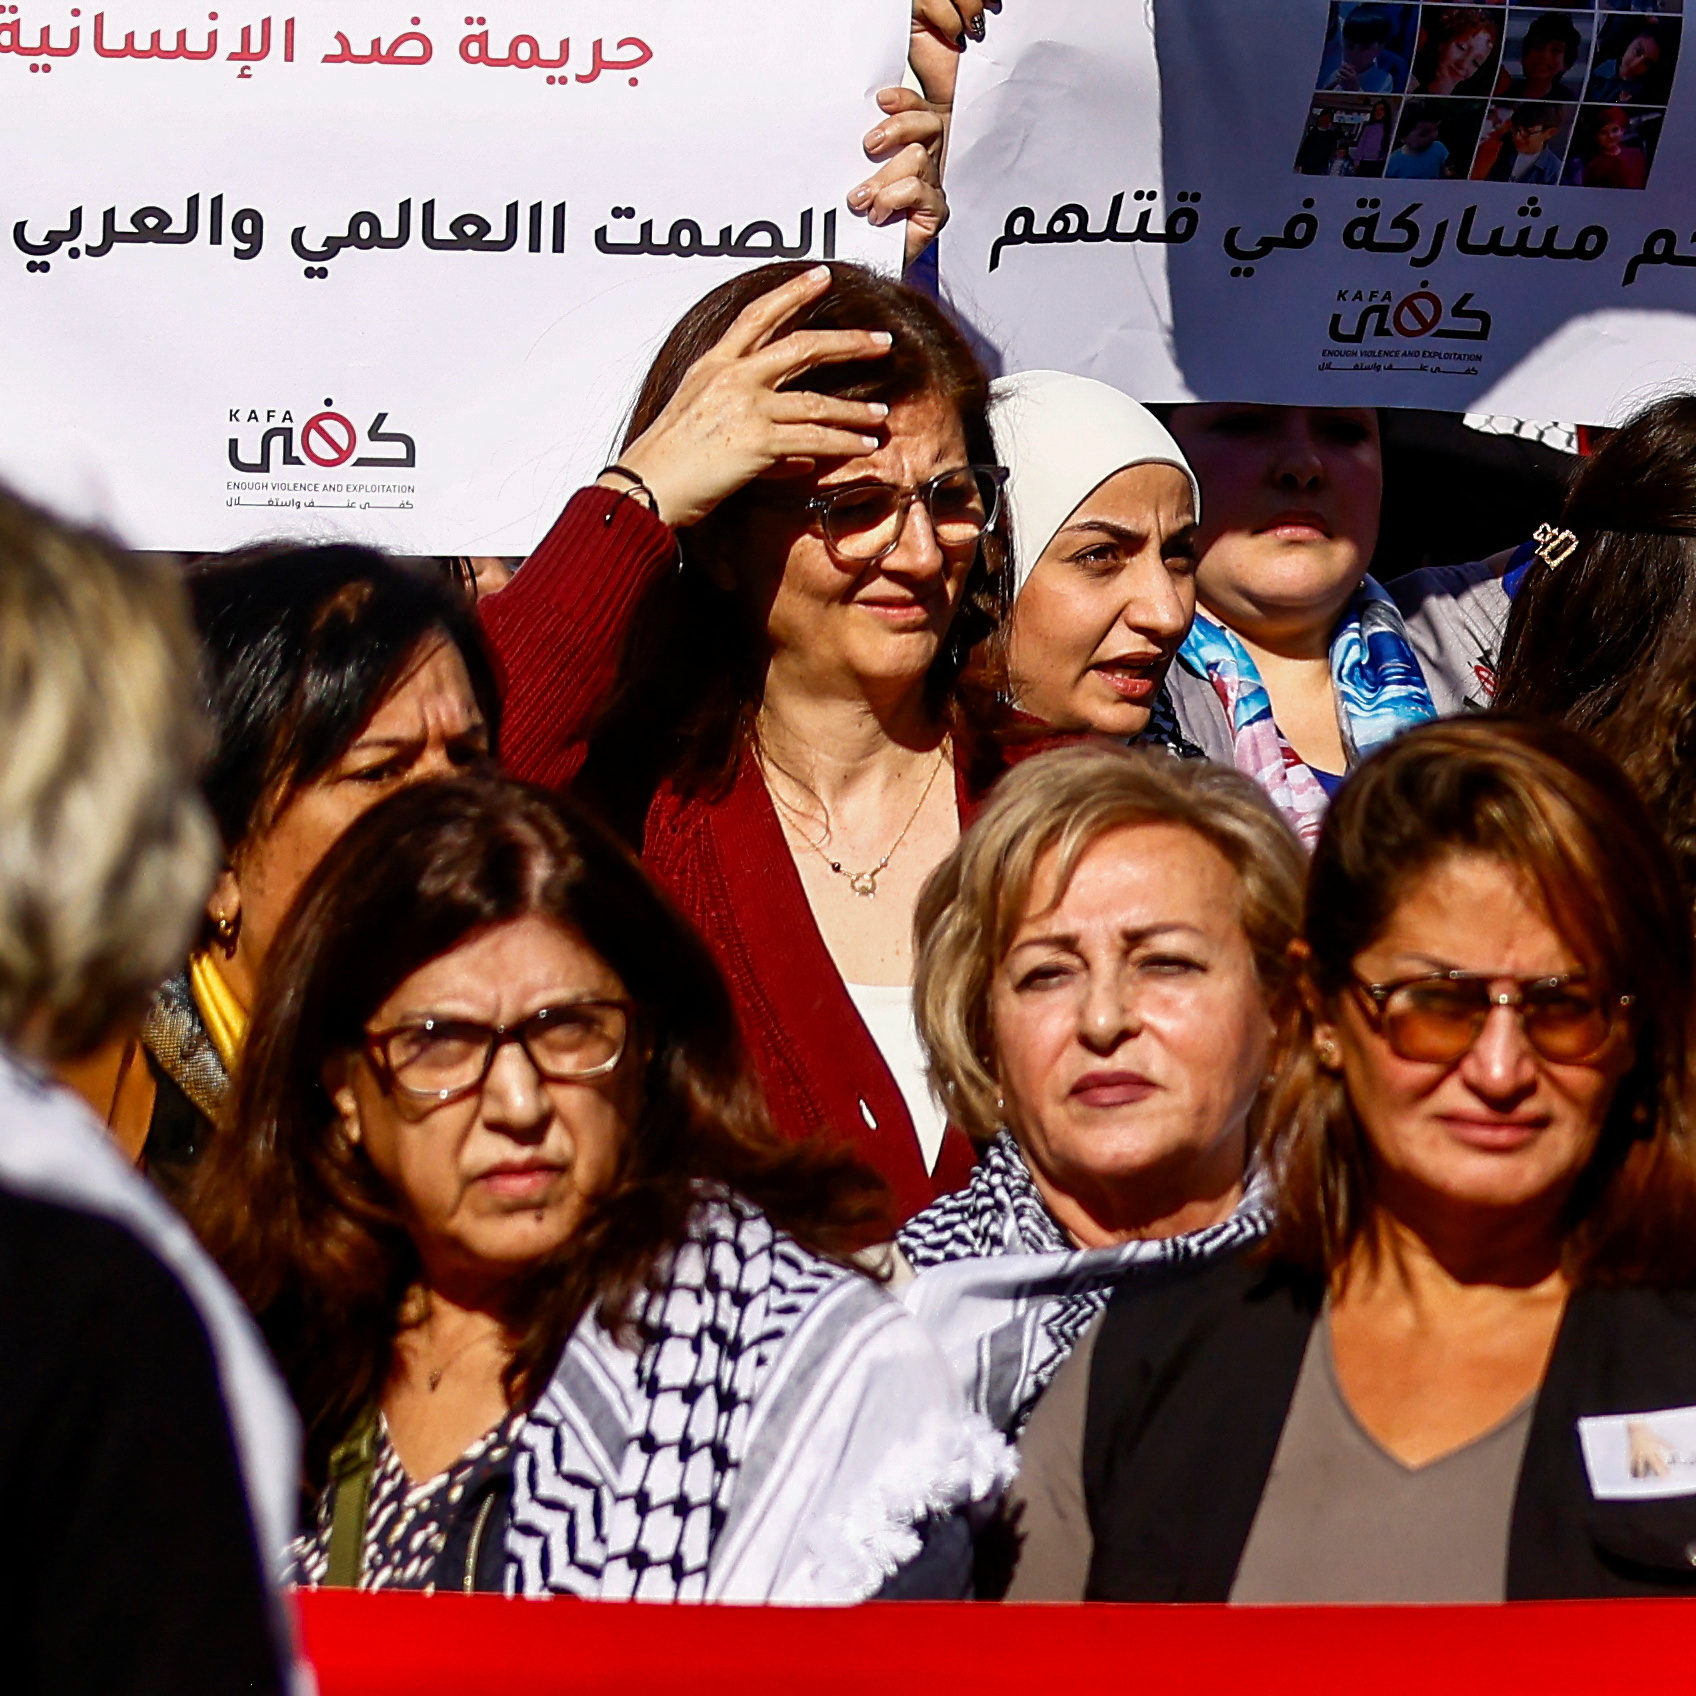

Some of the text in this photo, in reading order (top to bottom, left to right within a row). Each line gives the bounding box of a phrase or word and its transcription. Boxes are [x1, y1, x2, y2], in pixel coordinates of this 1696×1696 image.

[0, 4, 653, 87] جريمة ضد الإنسانية
[12, 192, 837, 280] الصمت االعالمي والعربي
[989, 190, 1202, 273] قتلهم
[1223, 197, 1319, 278] في
[1342, 196, 1609, 268] مشاركة
[1328, 279, 1491, 344] كفى
[1336, 289, 1393, 303] KAFA
[1322, 349, 1483, 362] ENOUGH VIOLENCE AND EXPLOITATION
[228, 397, 416, 473] كفى
[229, 409, 294, 423] KAFA
[226, 481, 415, 494] ENOUGH VIOLENCE AND EXPLOITATION
